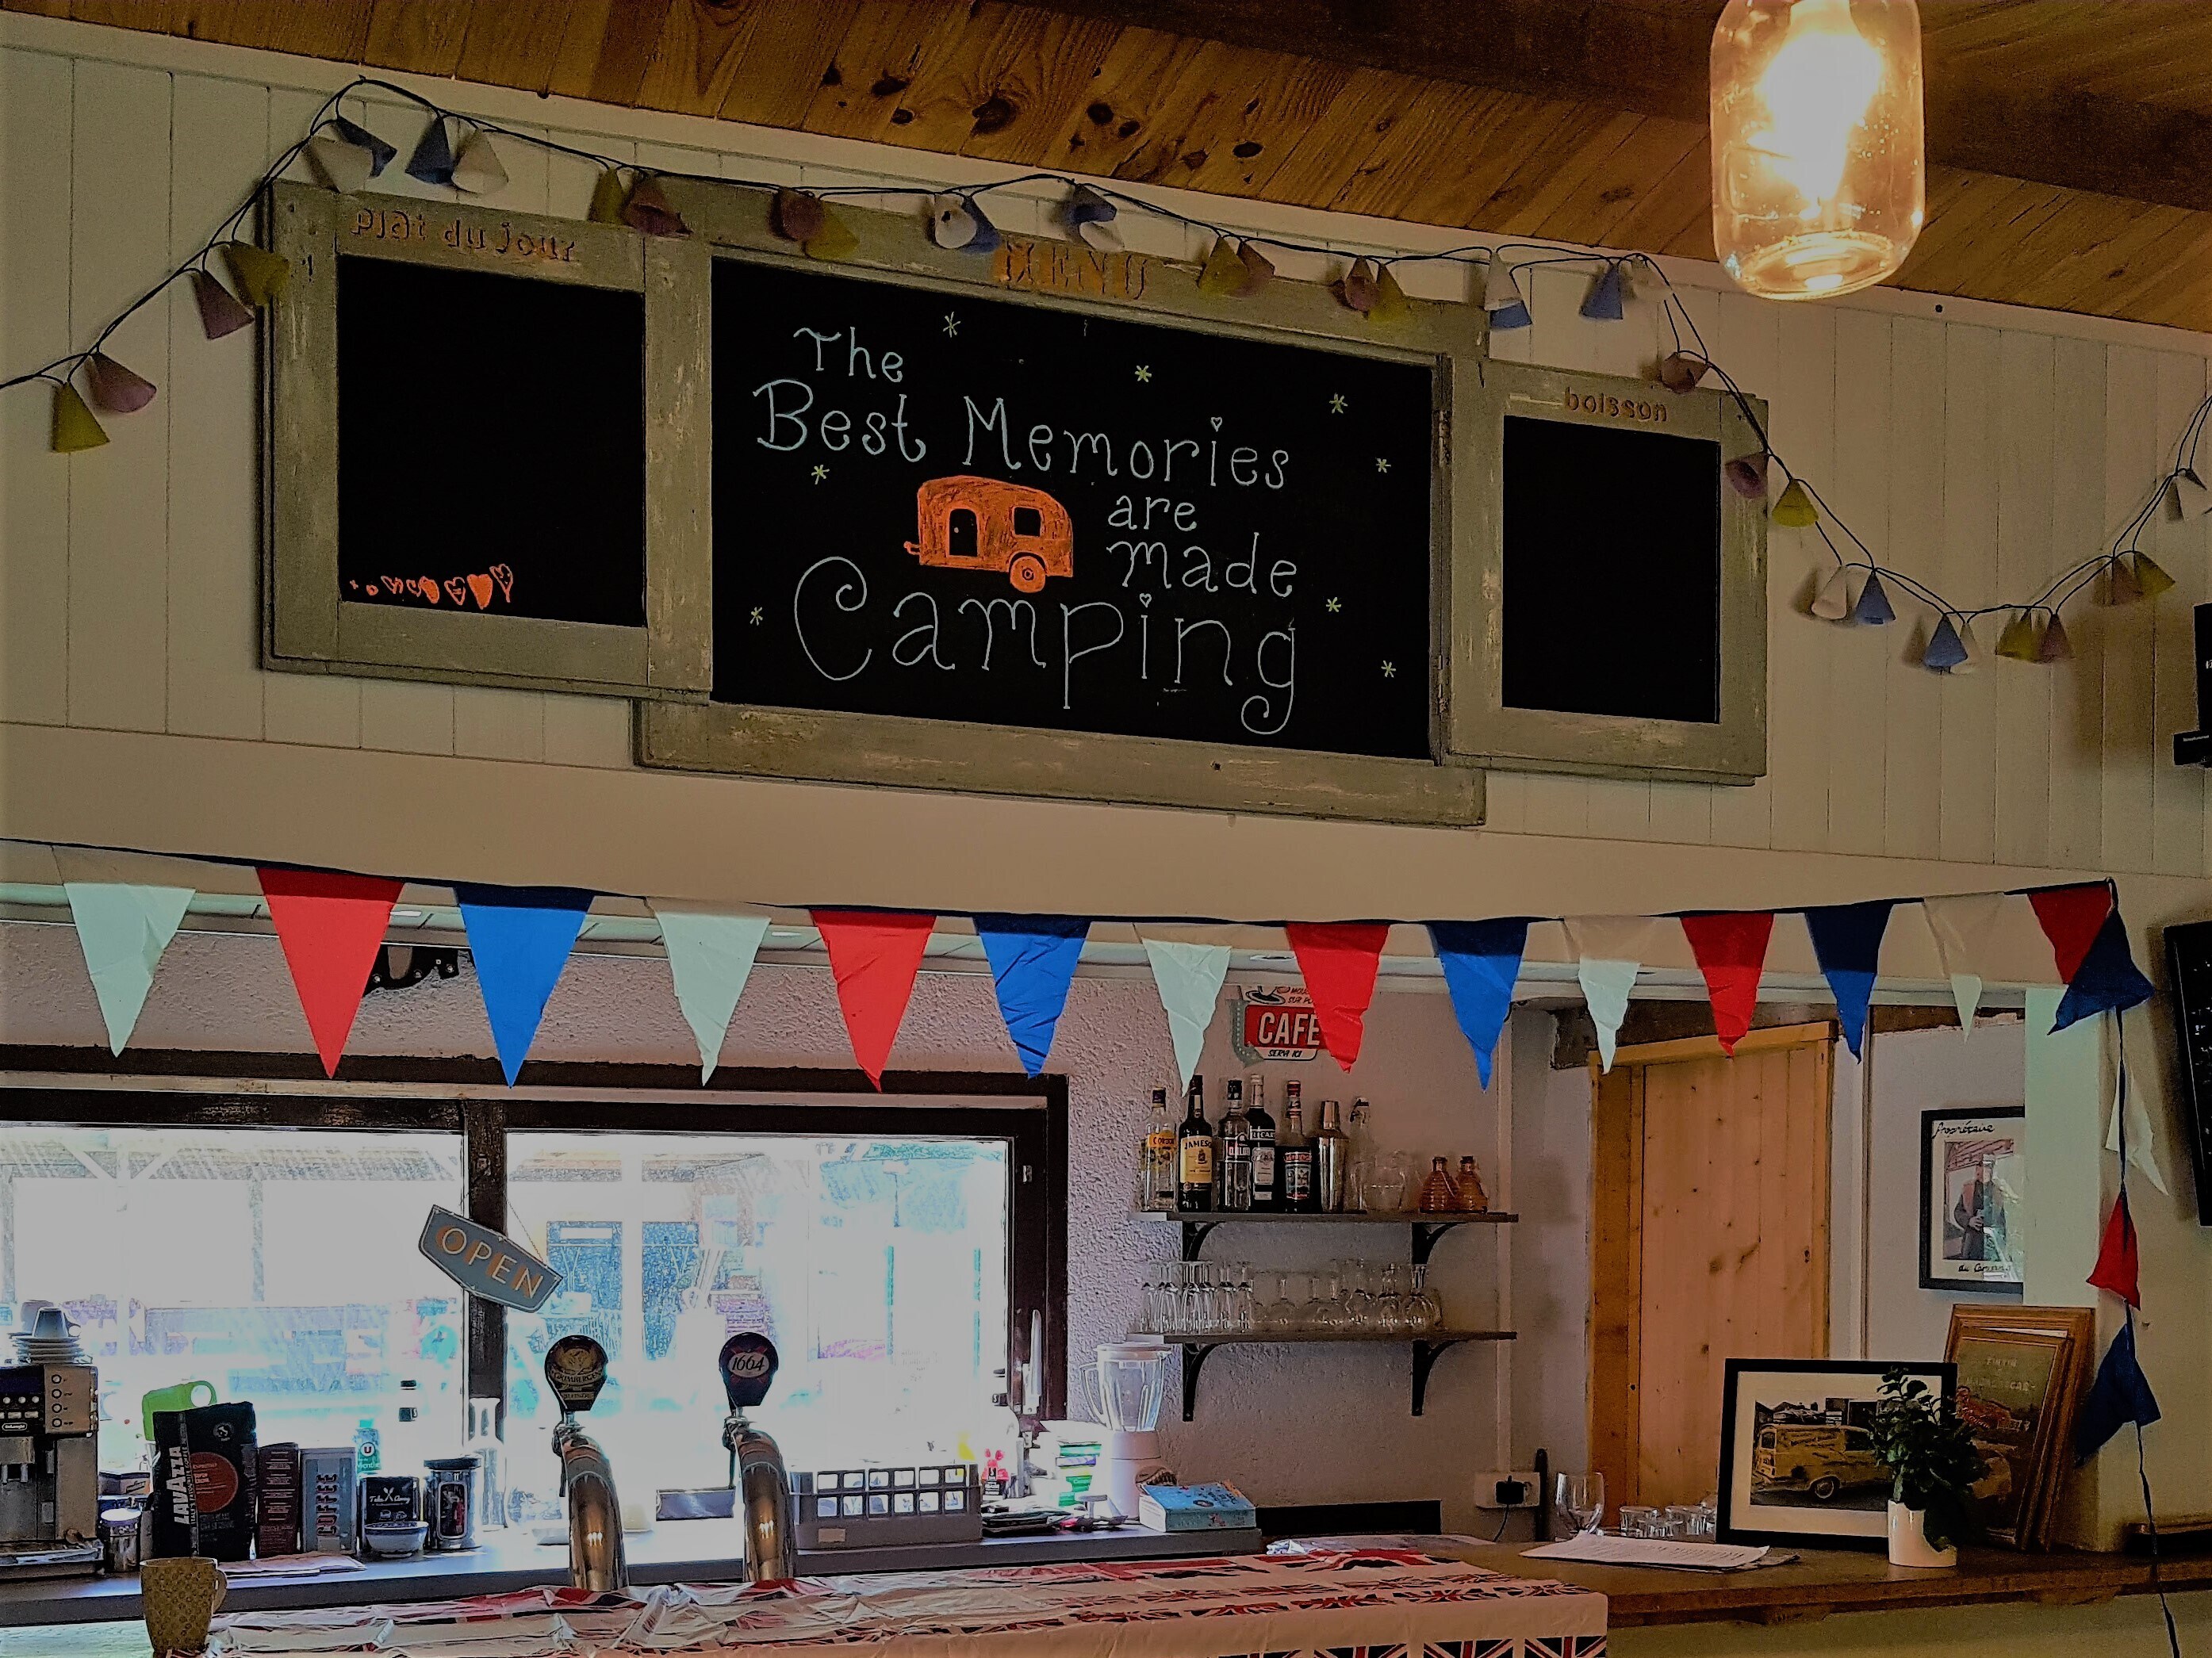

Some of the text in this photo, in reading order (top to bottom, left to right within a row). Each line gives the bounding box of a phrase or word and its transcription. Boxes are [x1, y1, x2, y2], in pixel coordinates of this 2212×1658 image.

[444, 220, 485, 250] du
[794, 326, 904, 383] The
[753, 377, 1290, 489] Best Memories
[1565, 386, 1667, 422] boisson
[1107, 494, 1198, 531] are
[1106, 532, 1298, 598] made
[794, 554, 1296, 735] Camping
[440, 1227, 543, 1299] OPEN
[732, 1354, 765, 1371] 1664
[167, 1446, 190, 1525] LAVAZZA
[316, 1474, 338, 1536] COFFEE
